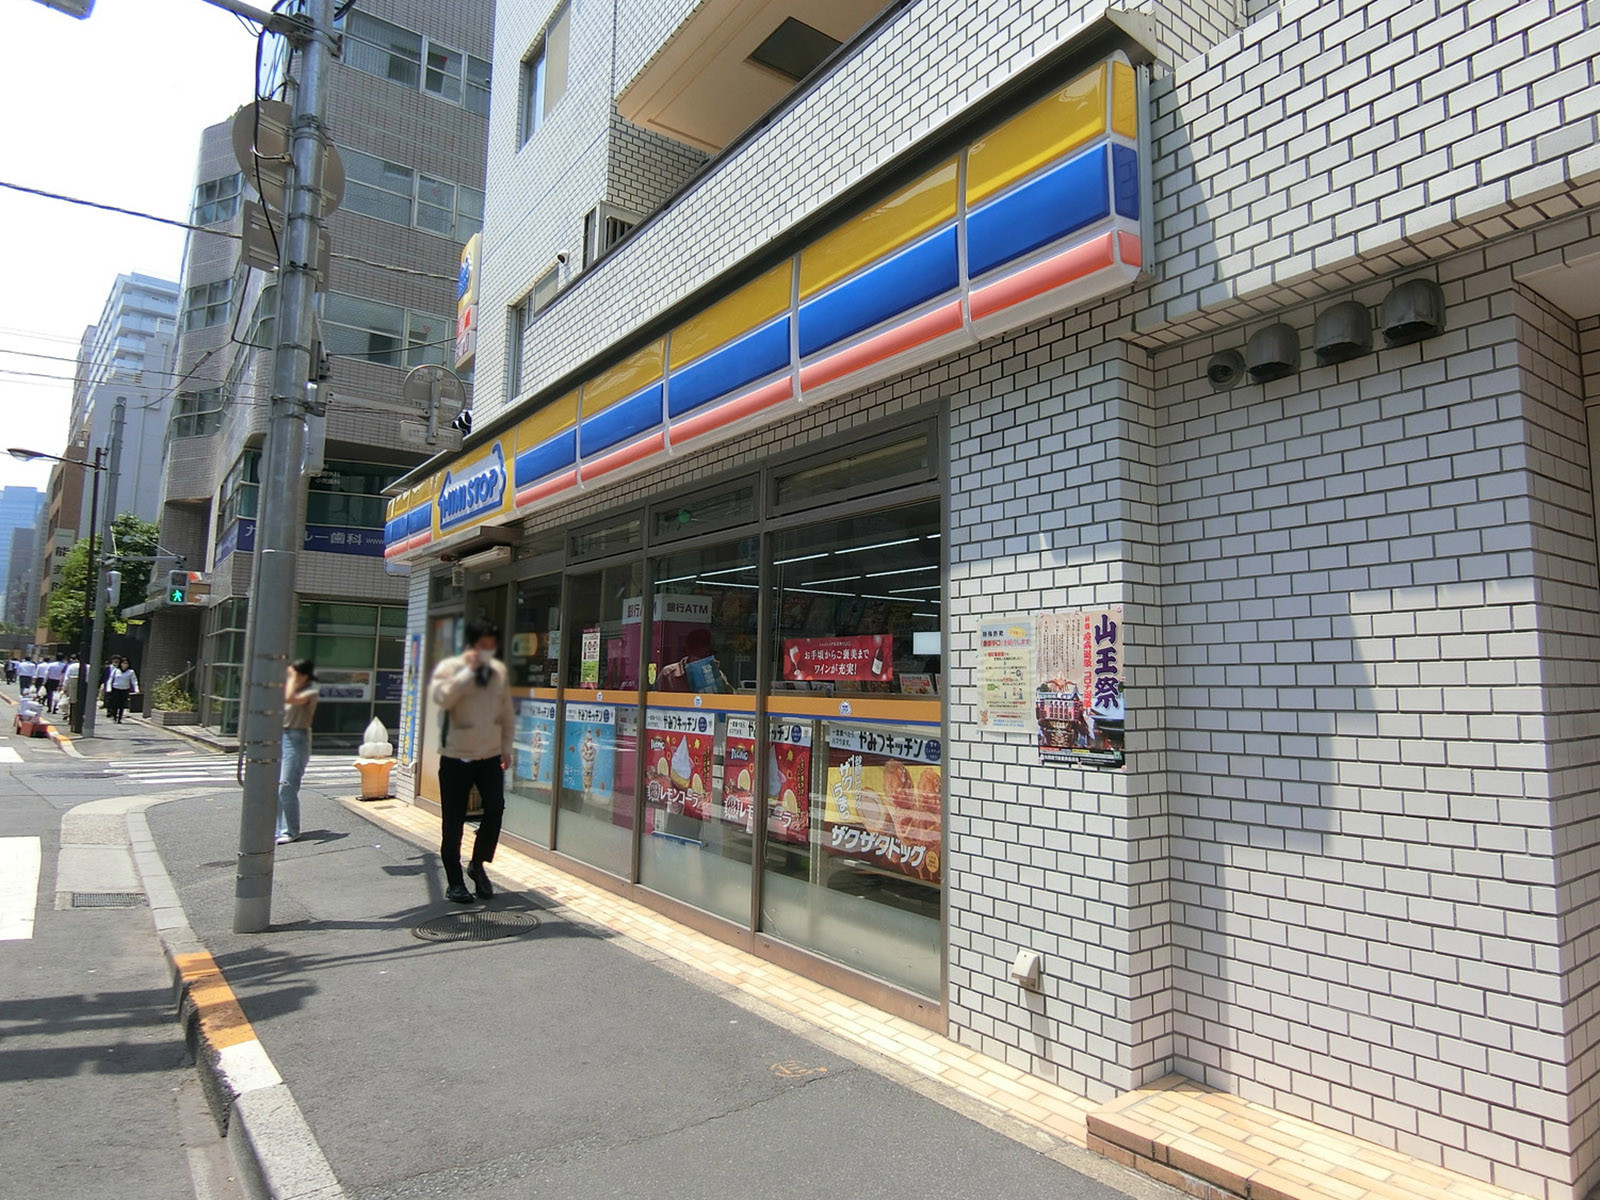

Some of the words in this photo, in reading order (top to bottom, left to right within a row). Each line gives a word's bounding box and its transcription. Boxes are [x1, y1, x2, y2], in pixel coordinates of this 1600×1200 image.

[442, 485, 467, 518] MINI
[467, 468, 498, 508] STOP
[666, 602, 708, 615] 銀行ATM
[804, 648, 869, 660] お手頃からご褒美まで
[1094, 613, 1119, 708] 山王祭
[663, 715, 698, 732] やみつキッチン
[859, 730, 924, 758] やみつキッチン
[660, 786, 699, 808] レモンコーラ
